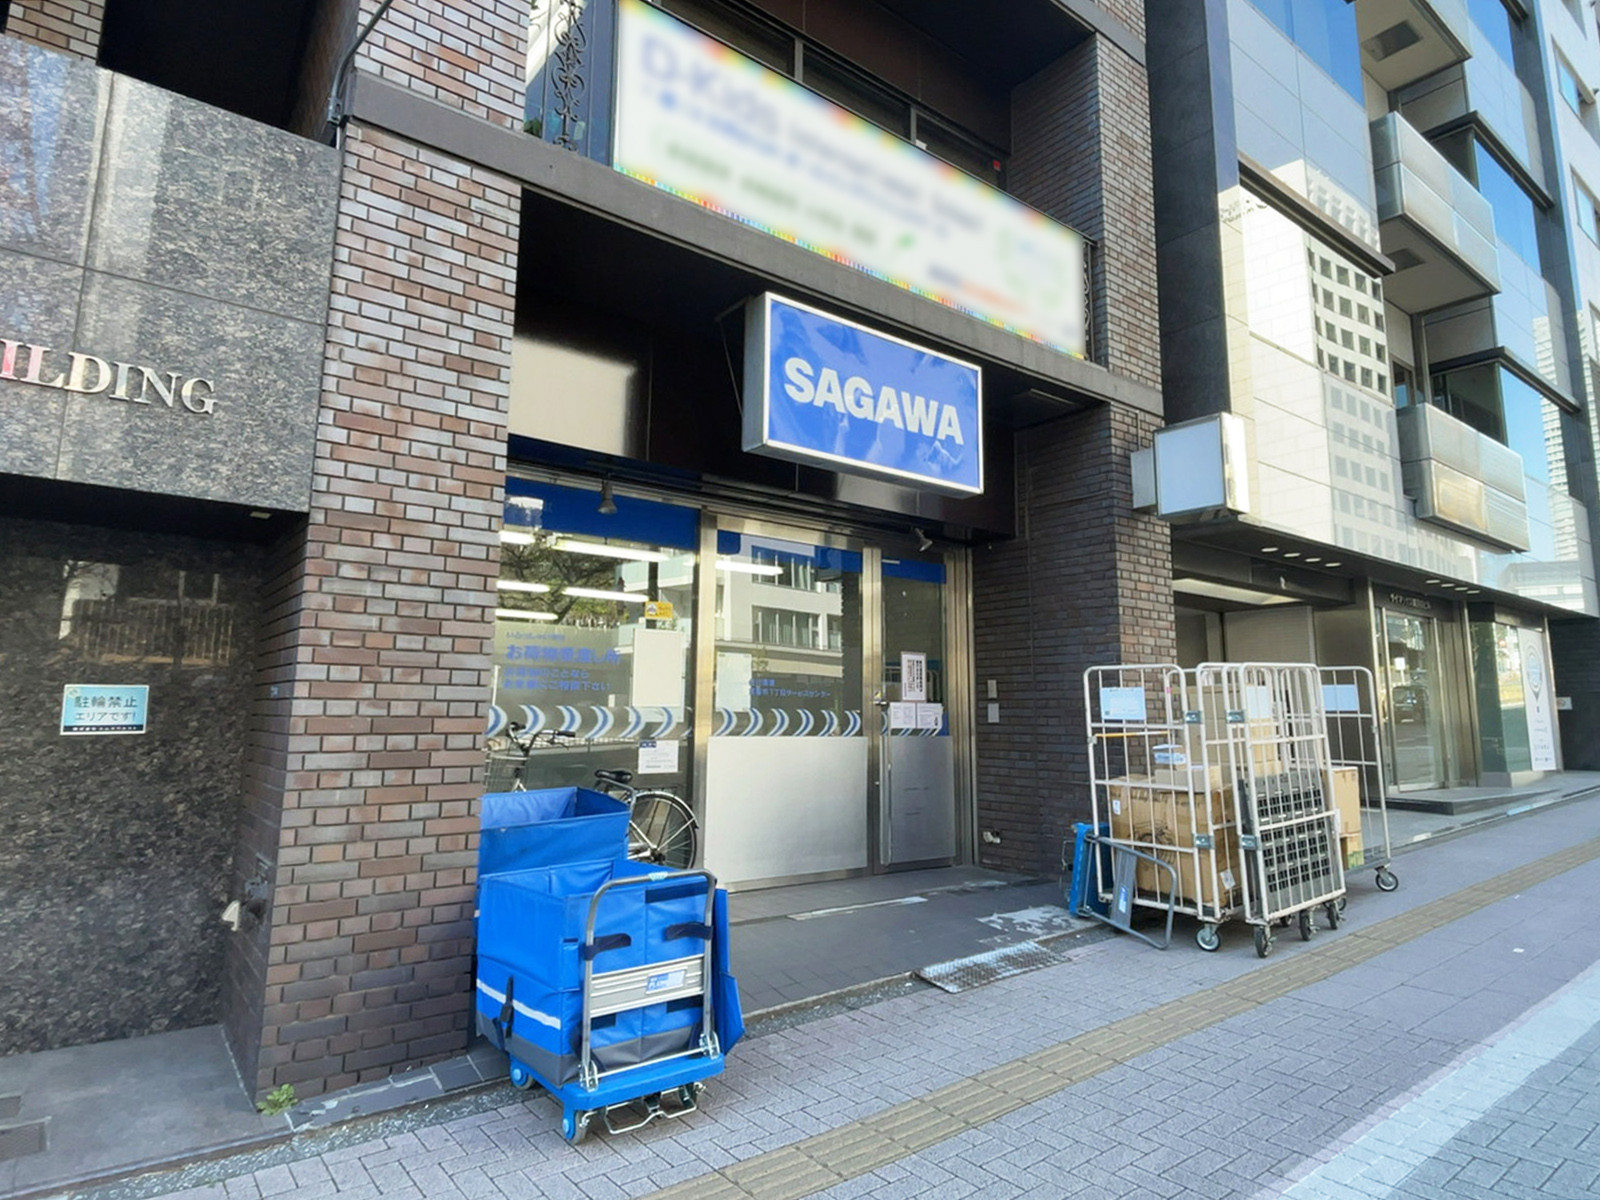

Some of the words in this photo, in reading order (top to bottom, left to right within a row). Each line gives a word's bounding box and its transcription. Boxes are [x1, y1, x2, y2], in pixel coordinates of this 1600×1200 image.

[0, 338, 219, 415] ILDING
[784, 356, 965, 446] SAGAWA
[74, 695, 138, 709] 駐輪禁止
